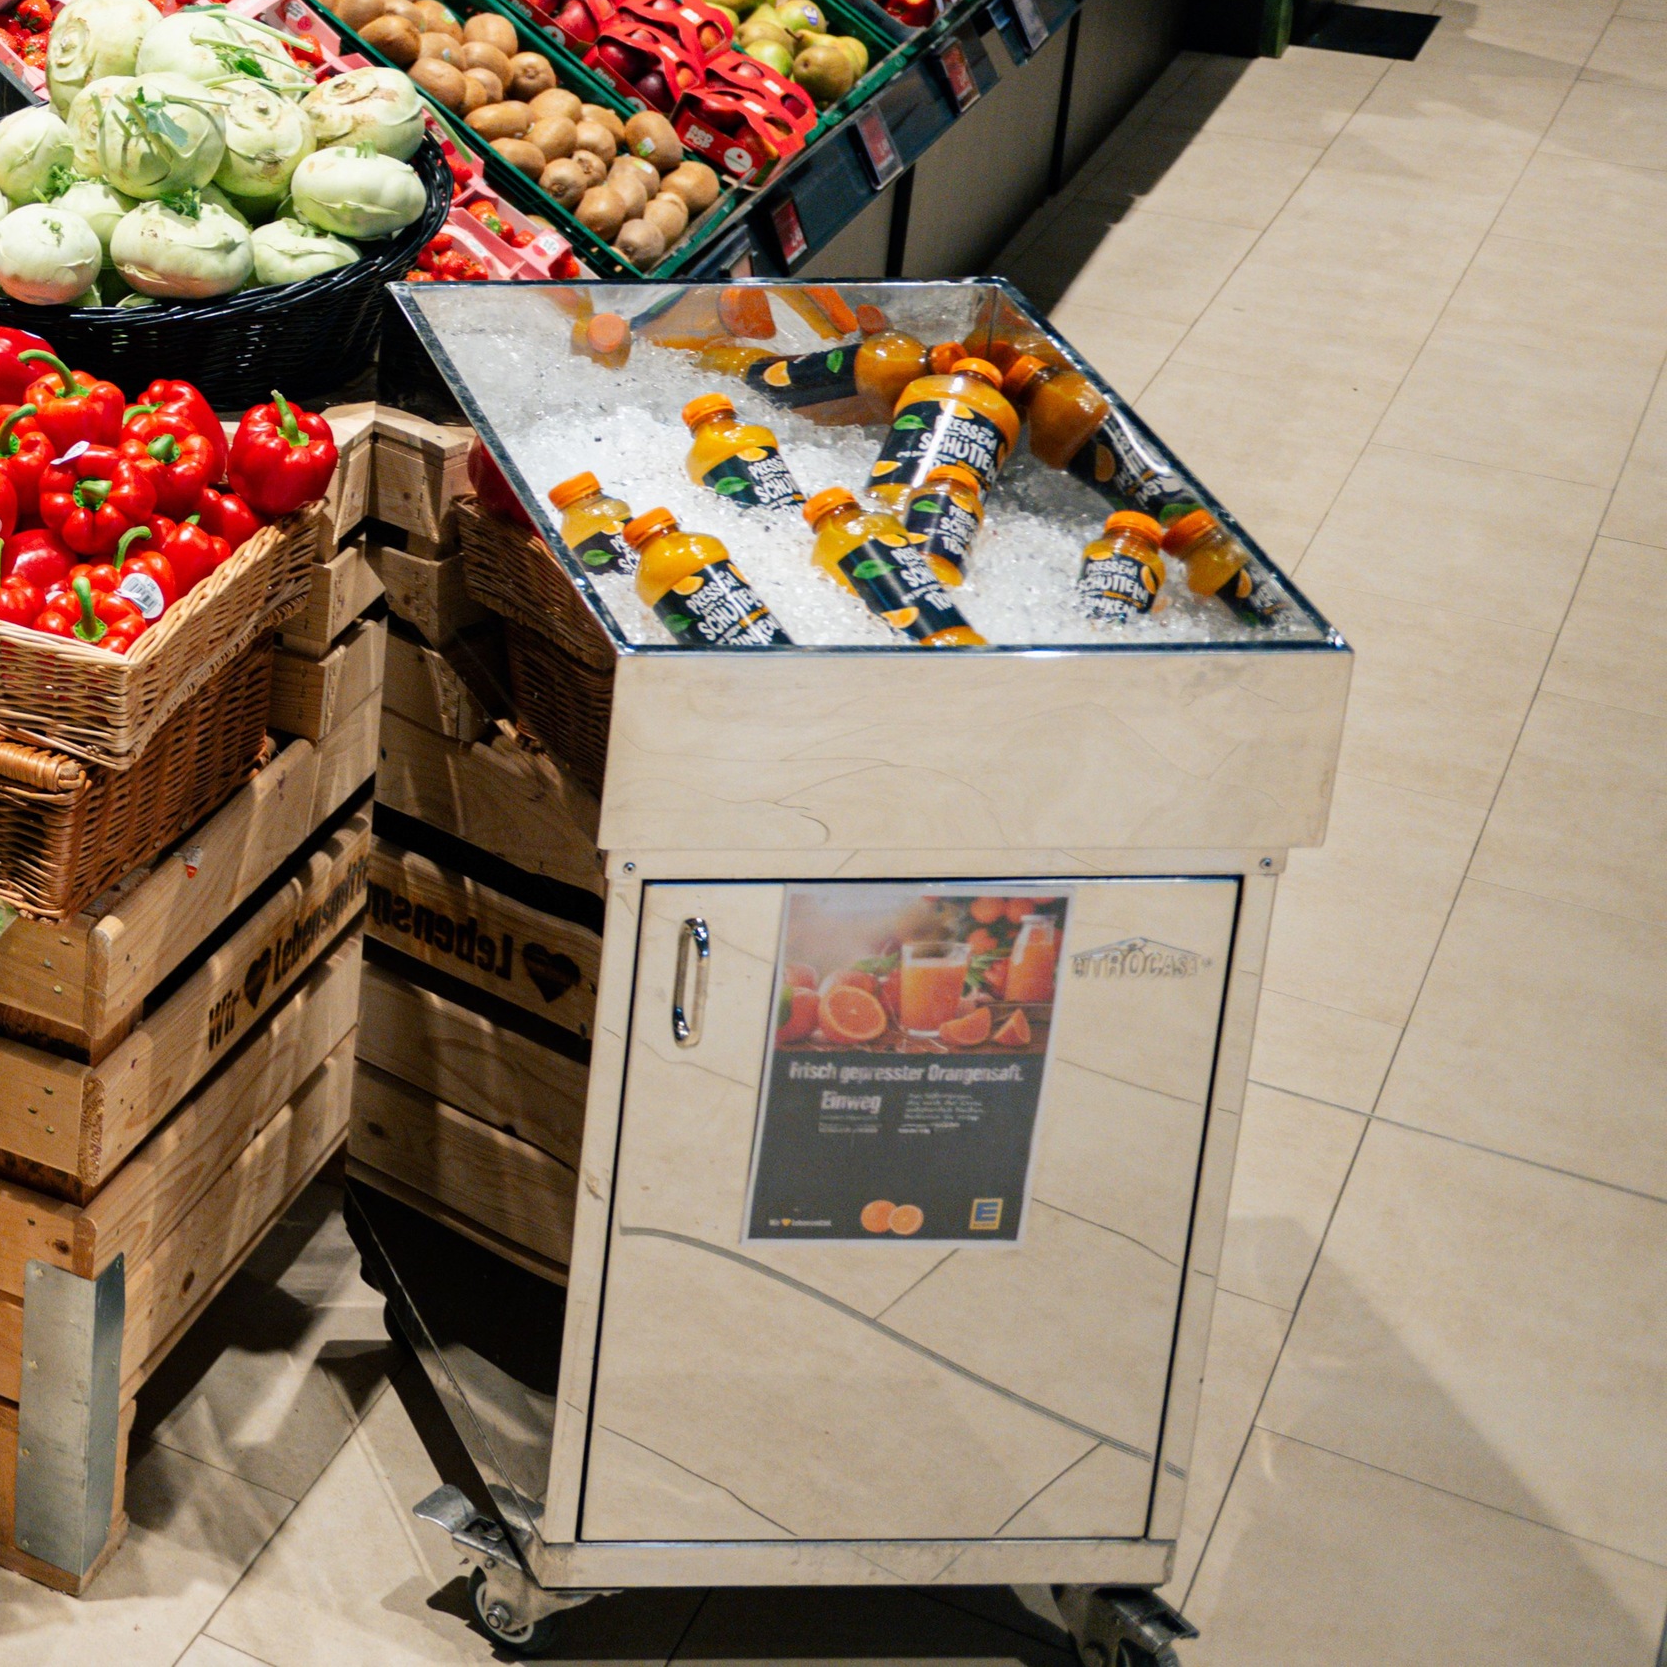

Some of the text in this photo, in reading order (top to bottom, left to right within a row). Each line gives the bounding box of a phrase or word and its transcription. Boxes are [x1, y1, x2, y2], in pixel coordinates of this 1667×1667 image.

[788, 1061, 1024, 1085] Frisch gepresster Orangensaft.
[821, 1090, 882, 1115] Einweg
